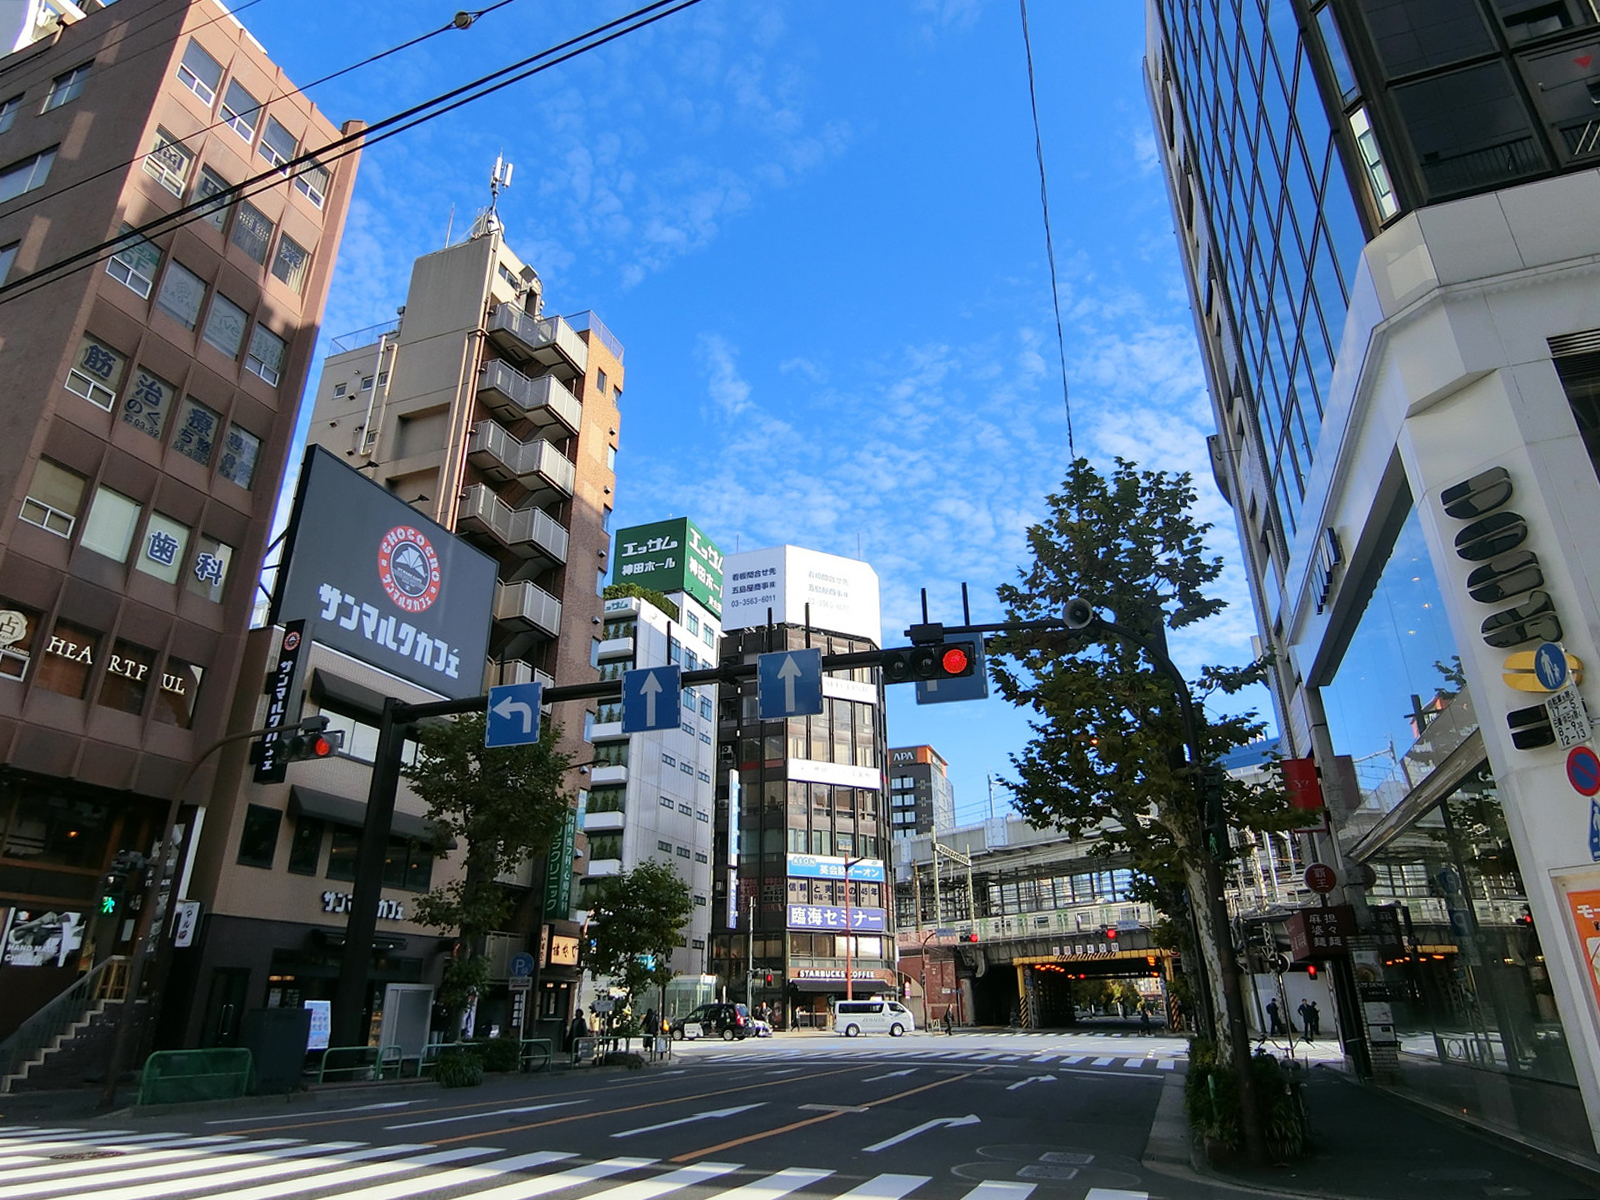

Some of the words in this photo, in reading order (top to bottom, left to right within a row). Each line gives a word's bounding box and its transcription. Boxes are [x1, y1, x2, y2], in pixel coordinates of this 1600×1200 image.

[621, 535, 678, 557] エッサム
[147, 529, 224, 586] 歯科
[621, 557, 676, 576] 神田ホール
[731, 567, 777, 582] 看板問合せ先
[731, 594, 776, 608] 03-3563-6011
[318, 583, 461, 679] サンマルクカフェ
[1561, 729, 1587, 747] 12-13
[893, 751, 915, 762] APA
[791, 907, 882, 927] 臨海セミナー
[799, 970, 846, 978] STARBUCKS
